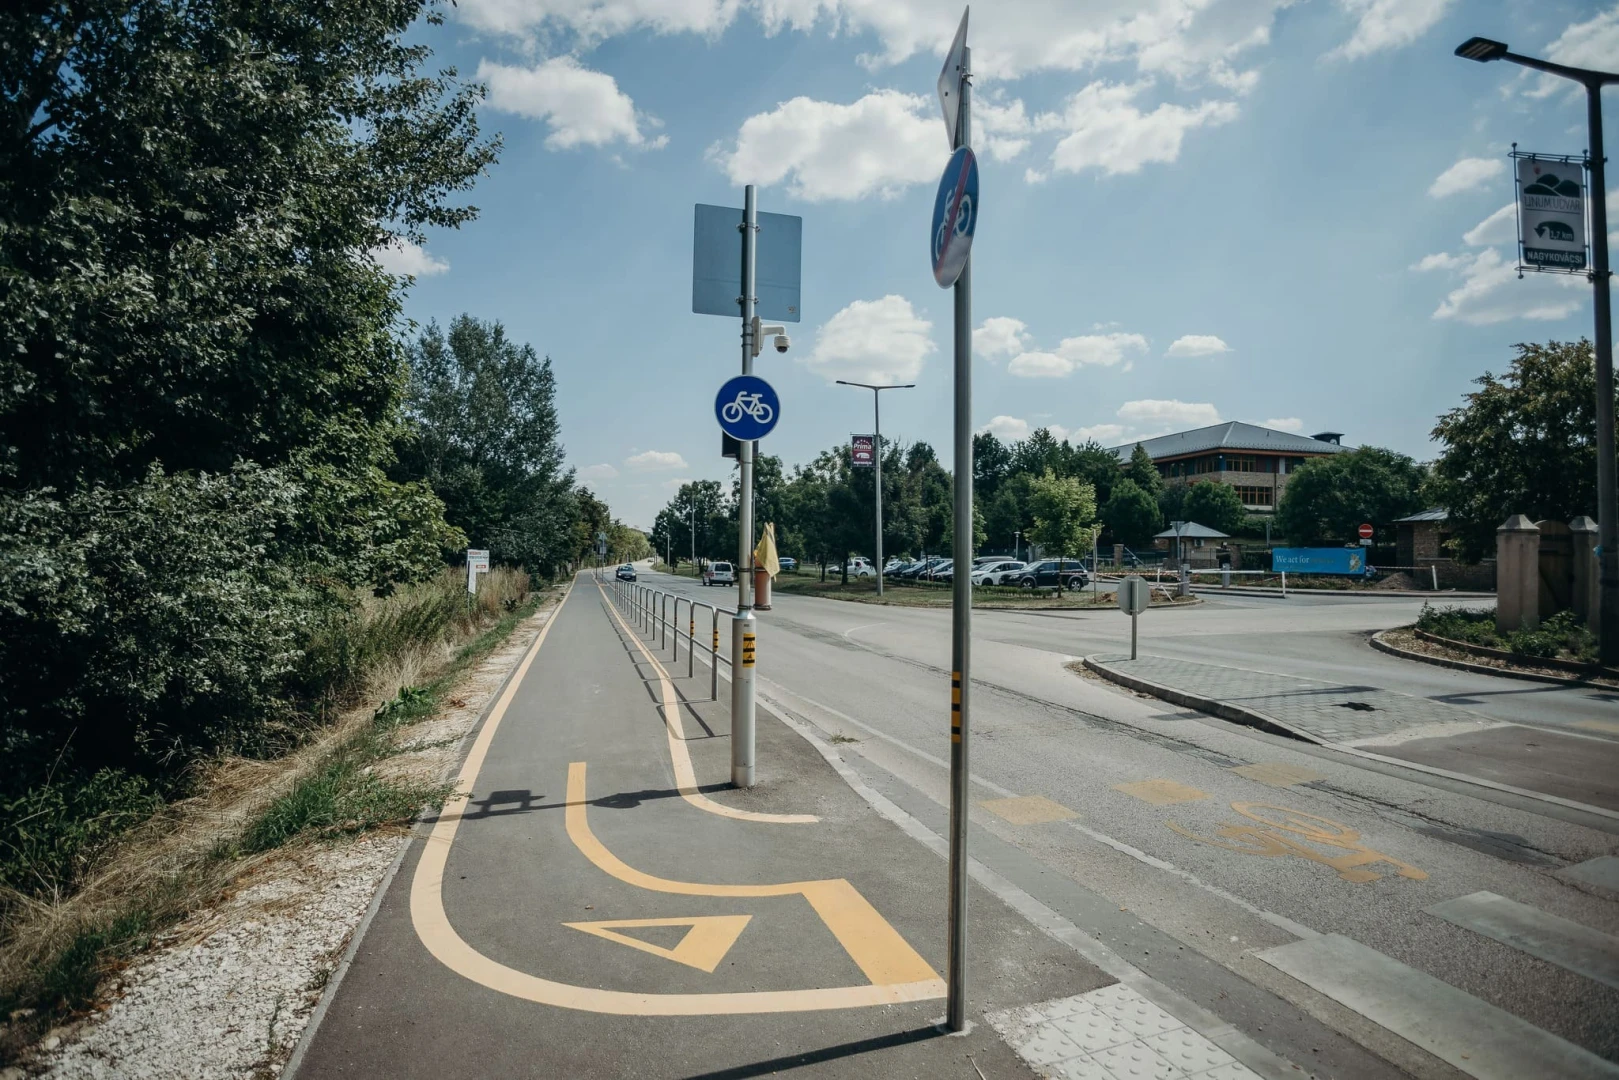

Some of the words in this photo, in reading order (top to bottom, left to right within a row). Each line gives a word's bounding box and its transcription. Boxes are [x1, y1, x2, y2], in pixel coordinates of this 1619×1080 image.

[1562, 231, 1573, 240] km
[1527, 251, 1583, 264] NAGYKOVÁCSI
[1276, 555, 1287, 563] We
[1299, 555, 1310, 563] for
